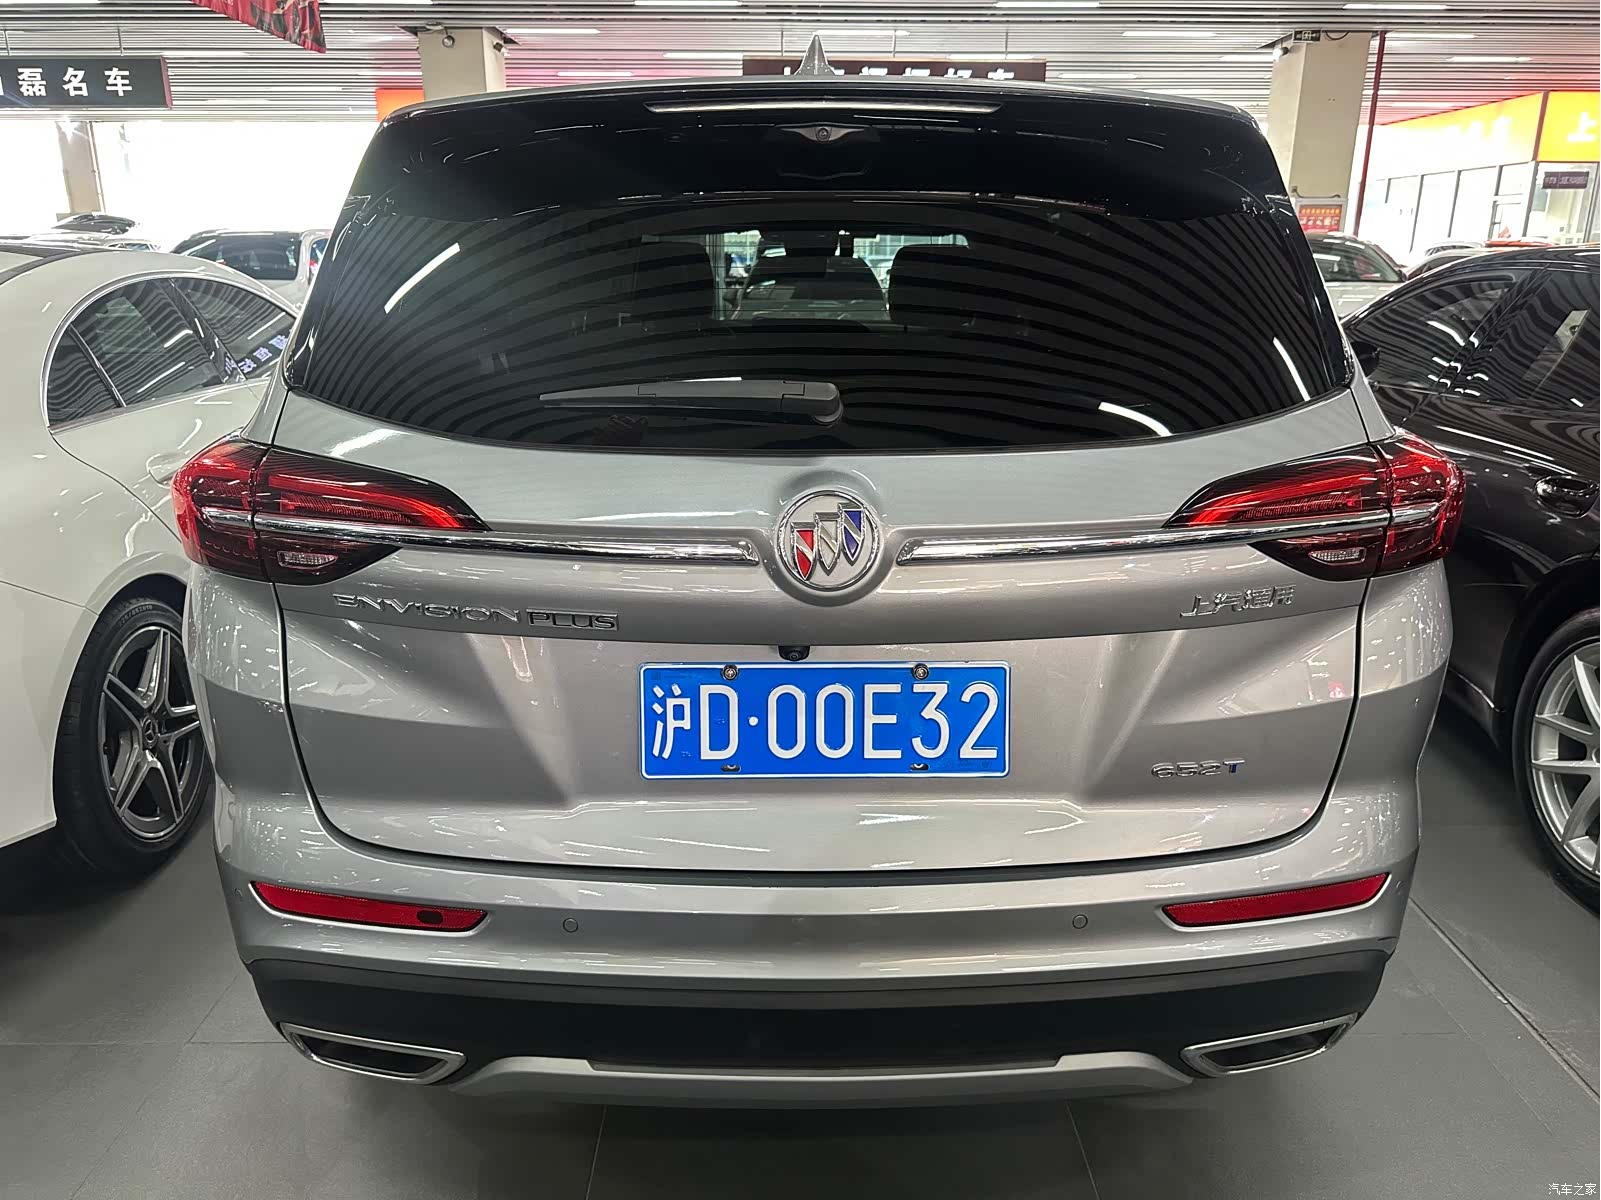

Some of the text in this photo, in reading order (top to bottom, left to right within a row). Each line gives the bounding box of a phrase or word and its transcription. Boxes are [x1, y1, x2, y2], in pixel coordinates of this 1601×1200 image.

[0, 66, 133, 97] 磊名车
[332, 593, 617, 630] ENVISION PLUS
[1180, 585, 1297, 617] 上汽通用
[1151, 758, 1245, 778] 652T
